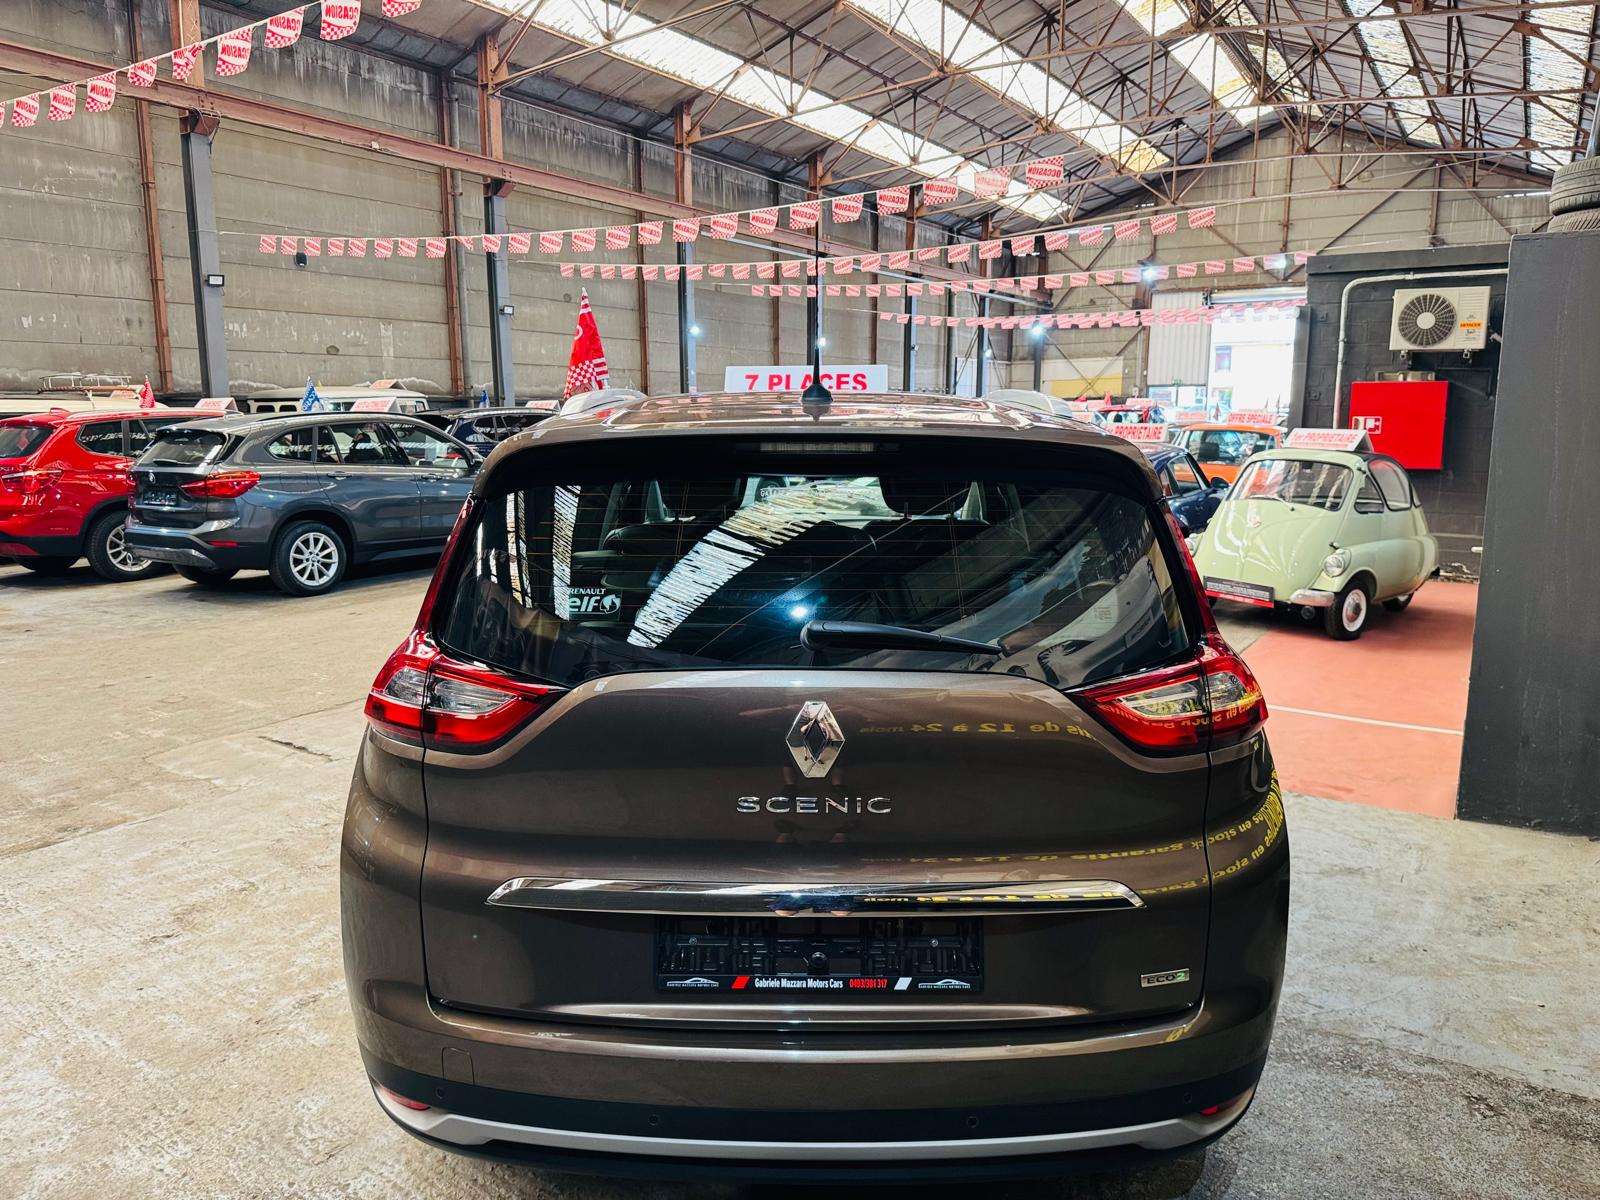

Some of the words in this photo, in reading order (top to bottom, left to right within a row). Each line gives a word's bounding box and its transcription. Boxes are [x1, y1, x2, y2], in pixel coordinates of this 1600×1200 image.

[745, 374, 759, 390] 7
[1113, 424, 1163, 441] PROPRIETAIRE
[567, 587, 606, 595] RENAULT
[736, 796, 892, 814] SCENIC
[755, 978, 780, 988] Gabriele
[781, 979, 806, 988] Mazzara
[807, 979, 829, 988] Motors
[829, 979, 843, 988] Cars
